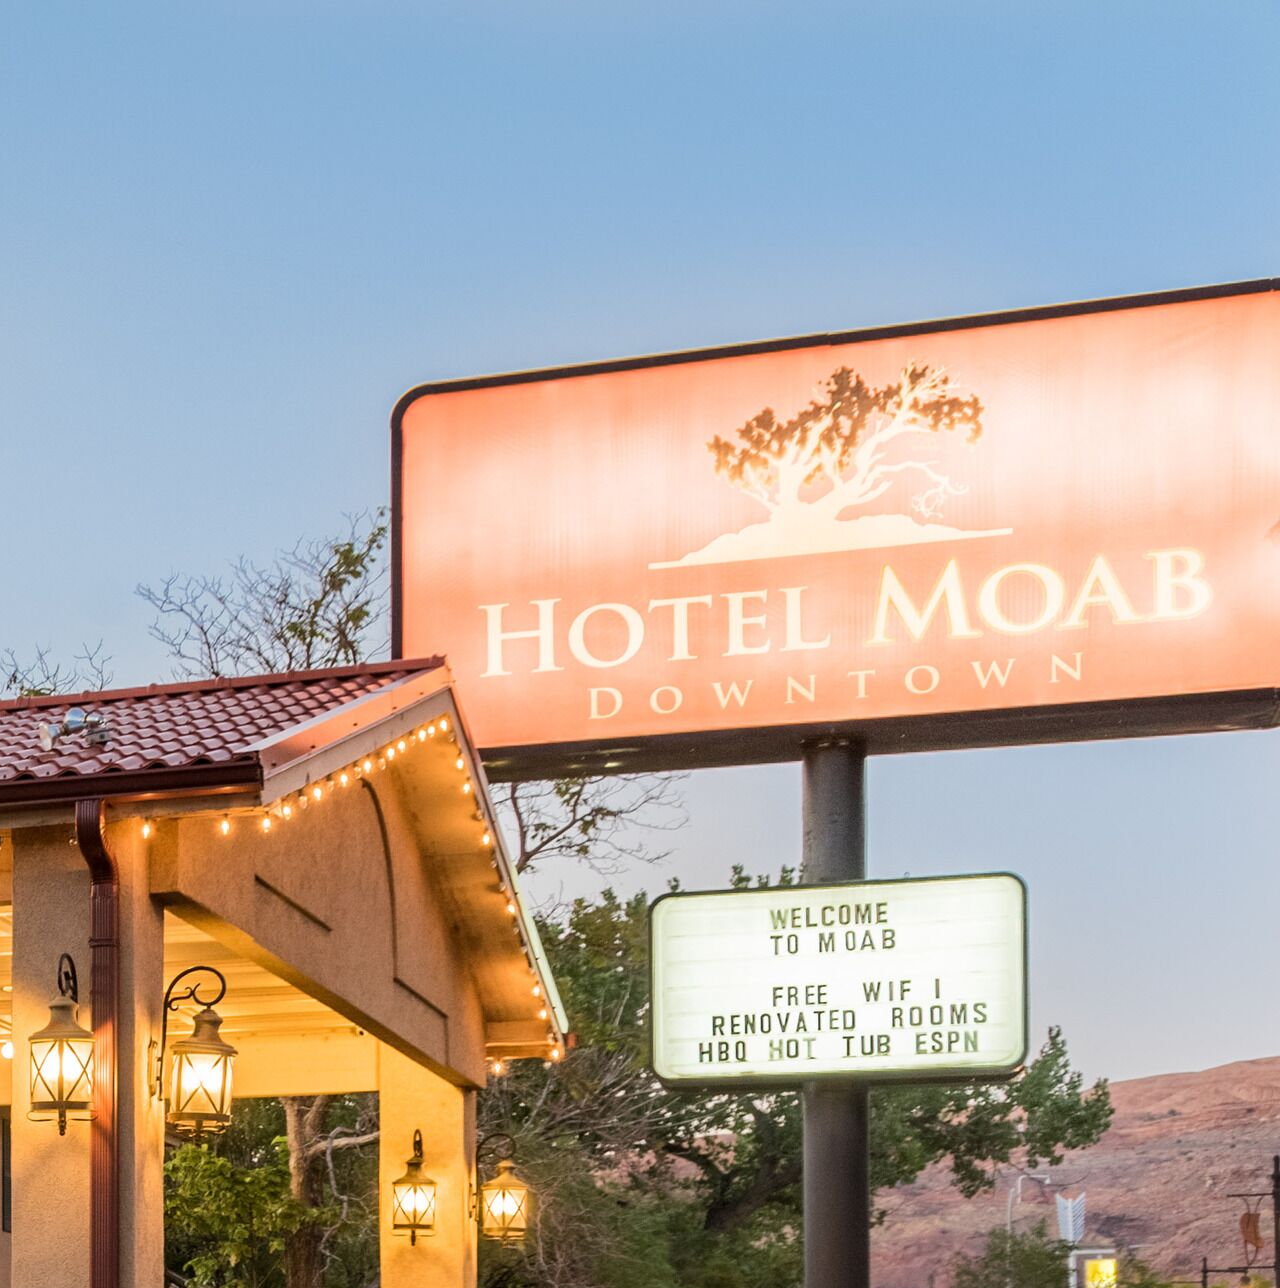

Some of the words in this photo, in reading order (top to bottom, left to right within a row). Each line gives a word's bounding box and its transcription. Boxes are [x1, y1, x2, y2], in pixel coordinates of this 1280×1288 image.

[477, 586, 831, 677] HOTEL
[864, 547, 1213, 646] MOAB
[588, 652, 1084, 720] DOWNTOWN
[770, 902, 888, 930] WELCOME
[770, 934, 799, 955] TO
[819, 929, 896, 952] MOAB
[772, 984, 828, 1007] FREE
[712, 1009, 856, 1036] RENOVATED
[892, 1003, 987, 1028] ROOMS
[768, 1038, 817, 1061] HOT
[842, 1034, 891, 1057] TUB
[915, 1031, 979, 1054] ESPN
